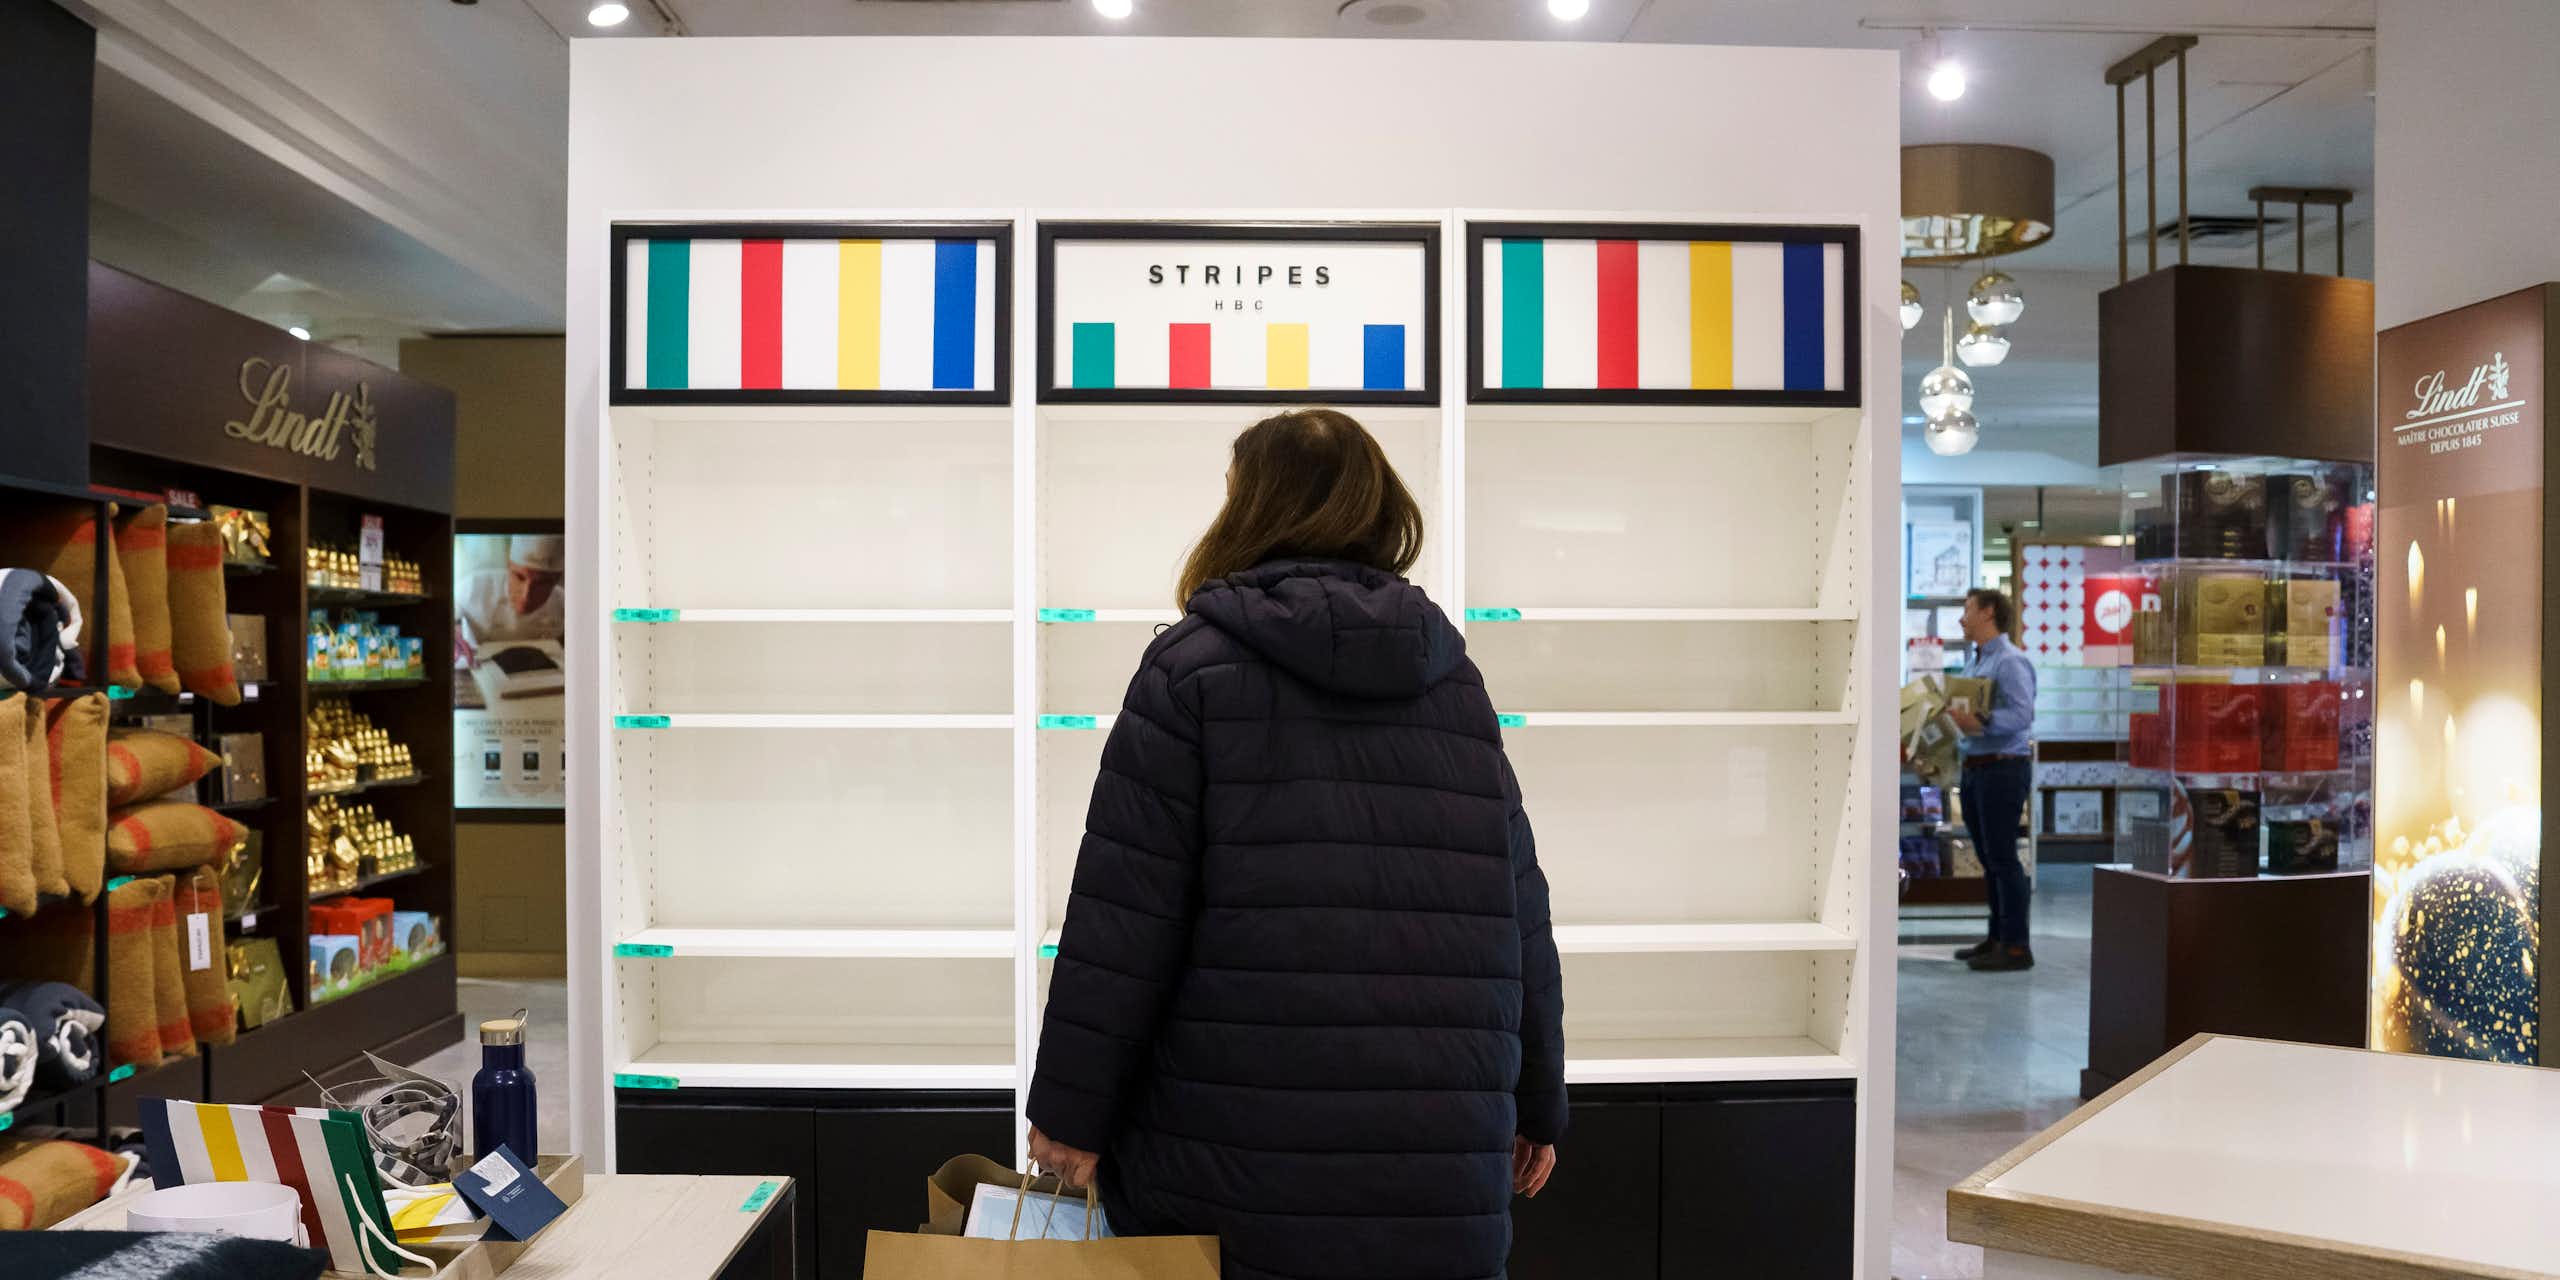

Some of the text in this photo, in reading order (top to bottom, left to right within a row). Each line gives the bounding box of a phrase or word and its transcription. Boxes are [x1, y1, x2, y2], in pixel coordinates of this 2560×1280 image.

[1149, 264, 1330, 285] STRIPES
[1215, 300, 1263, 311] HBC
[2406, 364, 2489, 419] Lindt
[224, 357, 350, 461] Lindt
[2428, 418, 2489, 440] CHOCOLATIER
[2490, 411, 2519, 428] SUISSE
[2430, 434, 2481, 454] DEPUIS 1845
[168, 489, 197, 508] SALE
